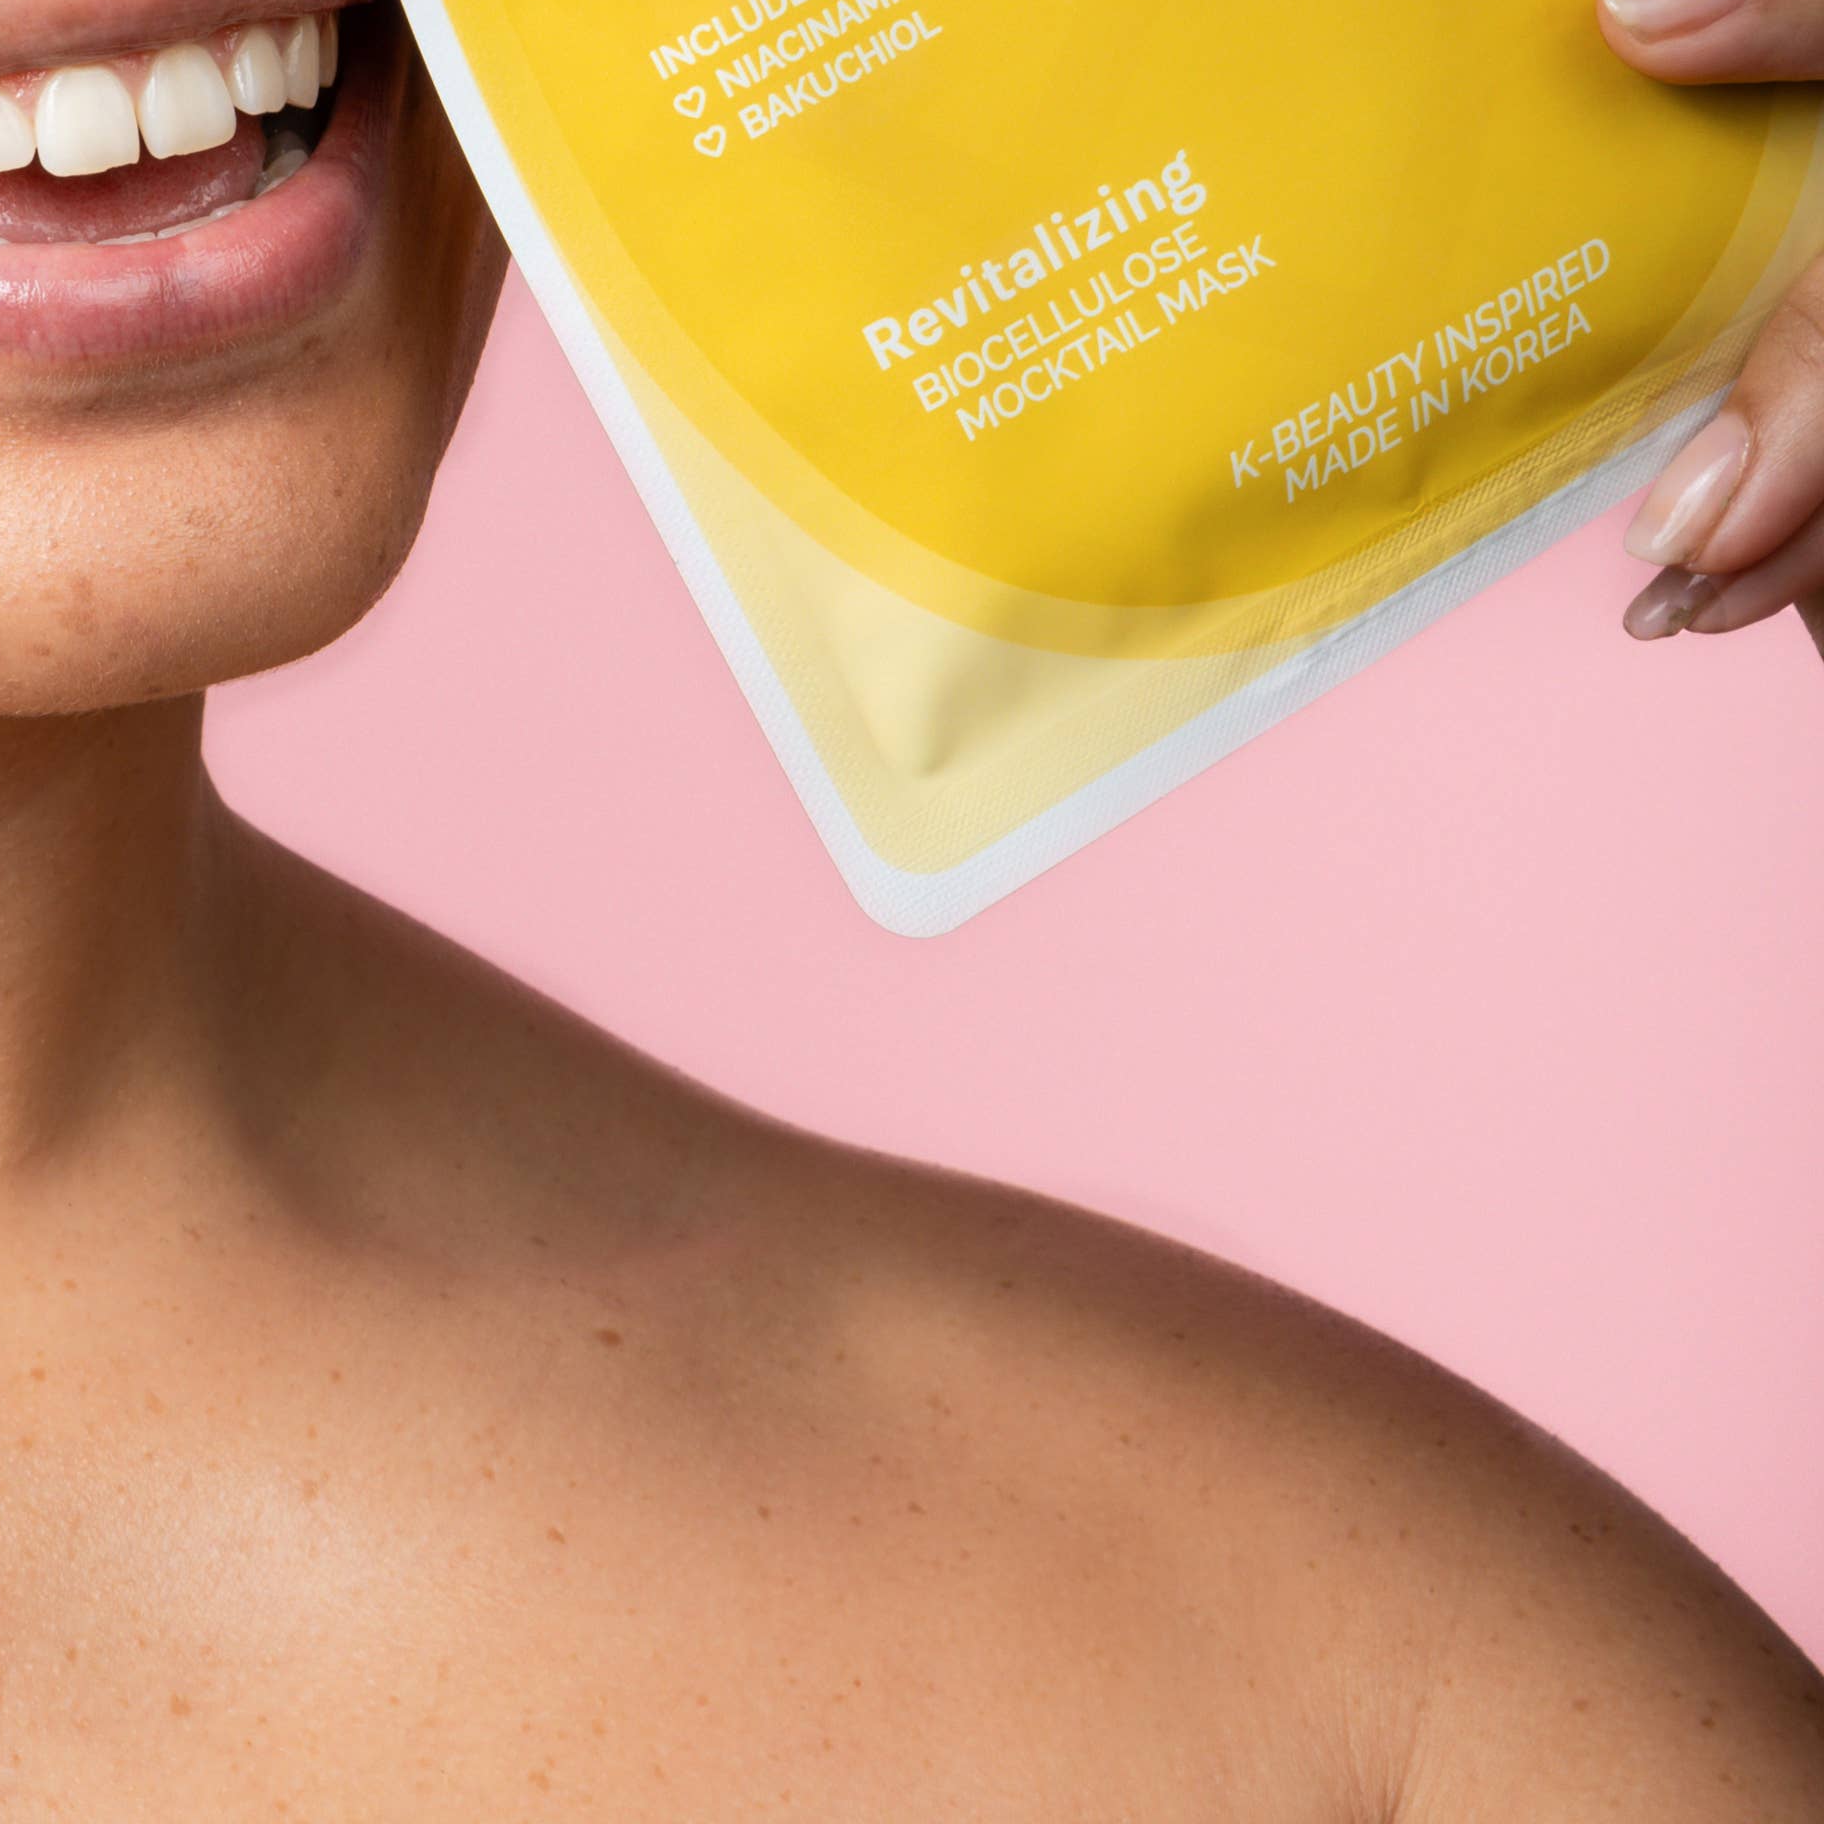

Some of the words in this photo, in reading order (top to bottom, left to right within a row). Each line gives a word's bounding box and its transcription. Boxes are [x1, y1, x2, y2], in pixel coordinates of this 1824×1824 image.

[738, 10, 943, 140] BAKUCHIOL
[861, 149, 1207, 370] Revitalizing
[912, 221, 1208, 413] BIOCELLULOSE
[955, 309, 1160, 442] MOCKTAIL
[1155, 234, 1277, 324] MASK
[1229, 341, 1425, 488] K-BEAUTY
[1435, 238, 1610, 369] INSPIRED
[1285, 408, 1403, 503] MADE
[1410, 380, 1449, 433] IN
[1462, 303, 1592, 402] KOREA
